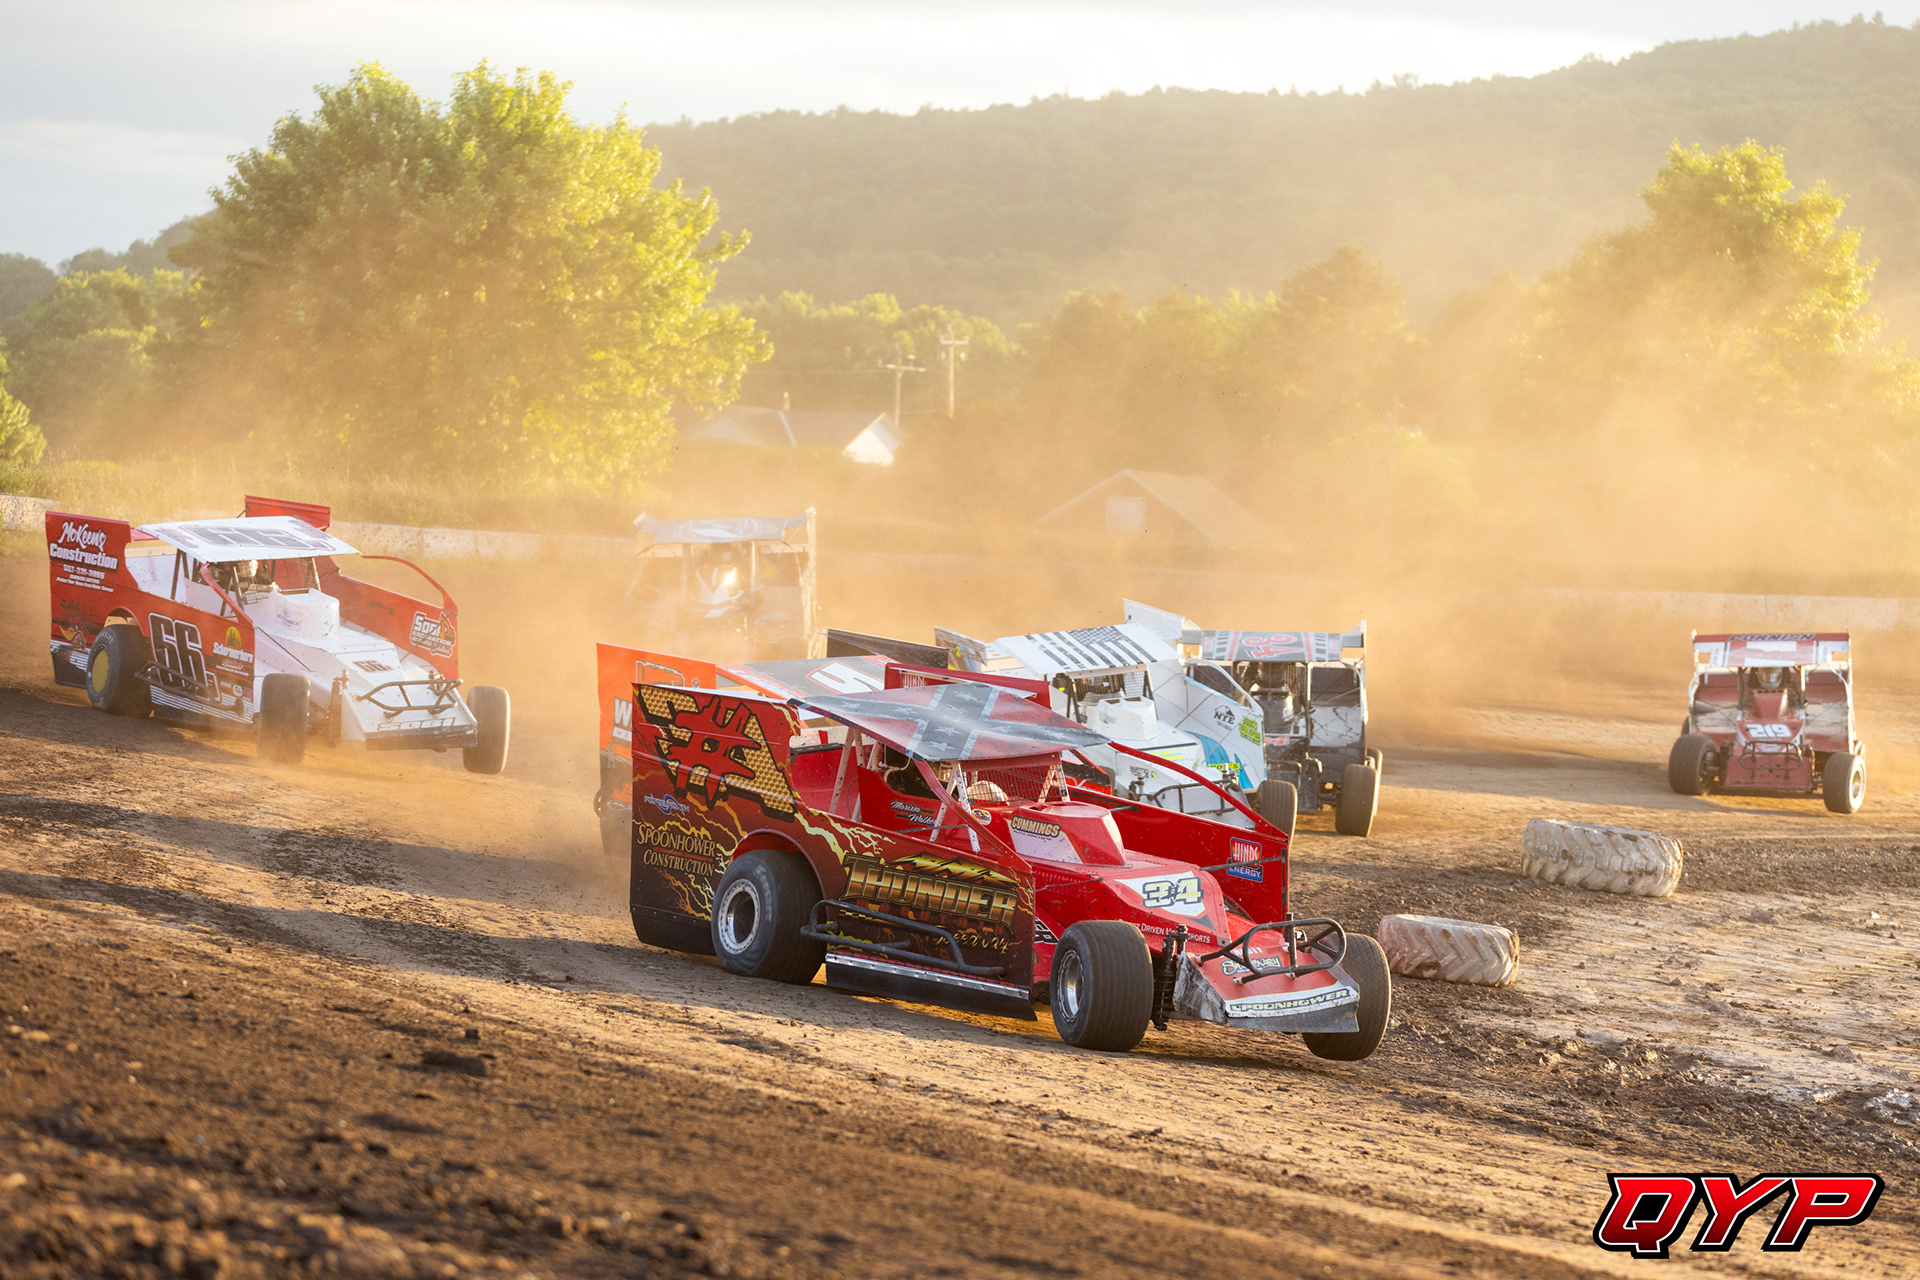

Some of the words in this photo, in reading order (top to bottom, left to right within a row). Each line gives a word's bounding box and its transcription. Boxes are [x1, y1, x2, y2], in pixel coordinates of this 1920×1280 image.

[50, 543, 118, 570] Construction
[1729, 633, 1816, 642] CORNISH
[1213, 711, 1235, 724] NYE
[1745, 723, 1793, 738] 219
[1012, 816, 1060, 837] CUMMINGS
[637, 824, 716, 857] SPOONHOWER
[643, 849, 715, 876] CONSTRUCTION
[1228, 866, 1262, 878] ENERGY
[839, 853, 1019, 935] THUNDER
[1143, 877, 1204, 907] 34
[935, 924, 1009, 955] Seedway
[1141, 923, 1165, 935] DRIVEN
[1166, 927, 1210, 943] MOSPORTS
[1231, 988, 1349, 1011] SPOONHOWER
